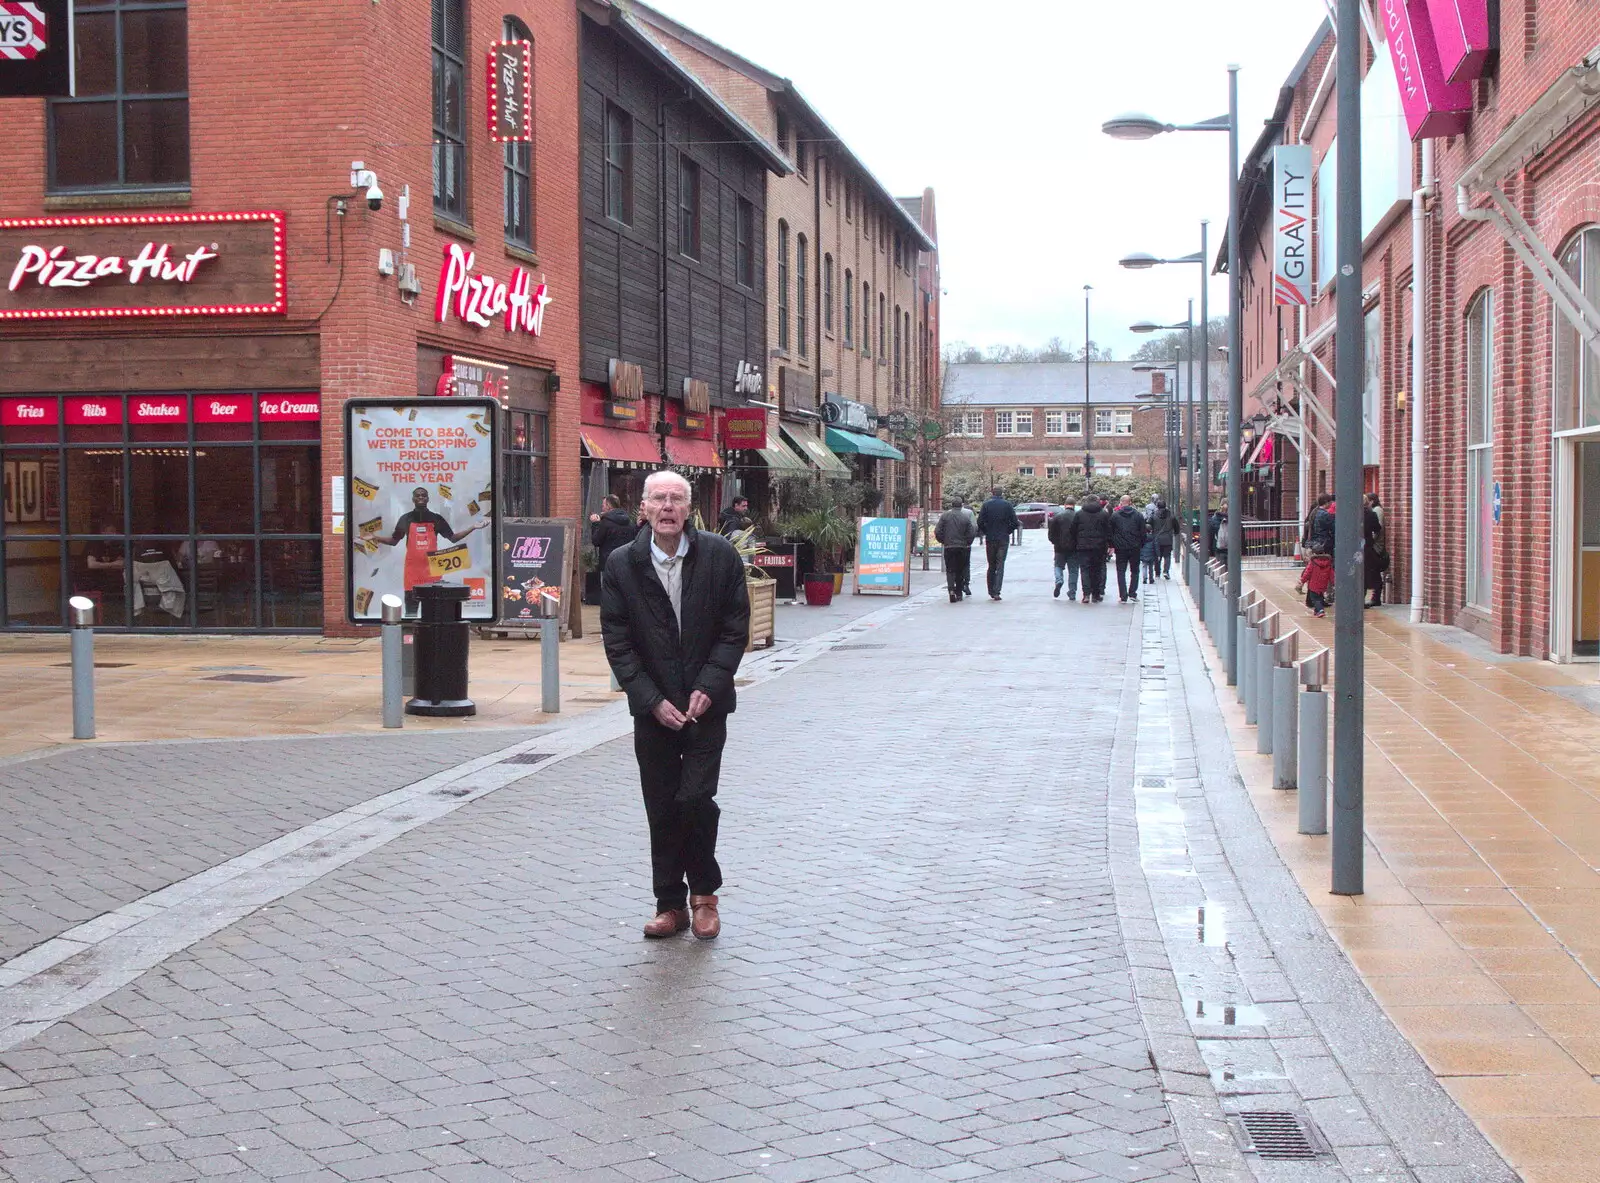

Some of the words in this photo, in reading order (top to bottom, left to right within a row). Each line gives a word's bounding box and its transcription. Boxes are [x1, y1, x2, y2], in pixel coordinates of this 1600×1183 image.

[502, 52, 518, 95] Pizza
[503, 96, 519, 130] Hut
[1279, 170, 1307, 279] GRAVITY
[8, 244, 125, 292] Pizza
[127, 242, 219, 284] Hut
[435, 243, 508, 328] Pizza
[506, 266, 553, 337] Hut
[16, 404, 45, 418] Fries
[81, 403, 107, 417] Ribs
[137, 402, 180, 416] Shakes
[210, 402, 238, 415] Beer
[260, 401, 279, 414] Ice
[280, 400, 319, 414] Cream
[375, 427, 413, 438] COME
[416, 427, 433, 438] TO
[437, 427, 469, 439] B&Q,
[367, 439, 405, 449] WE'RE
[409, 438, 477, 449] DROPPING
[400, 450, 445, 460] PRICES
[376, 461, 468, 472] THROUGHOUT
[391, 473, 416, 483] THE
[419, 473, 454, 483] YEAR
[890, 526, 899, 534] DO
[866, 534, 902, 542] WHATEVER
[868, 541, 882, 550] YOU
[884, 542, 899, 551] LIKE
[437, 556, 462, 571] £20
[764, 556, 786, 565] FAJITAS
